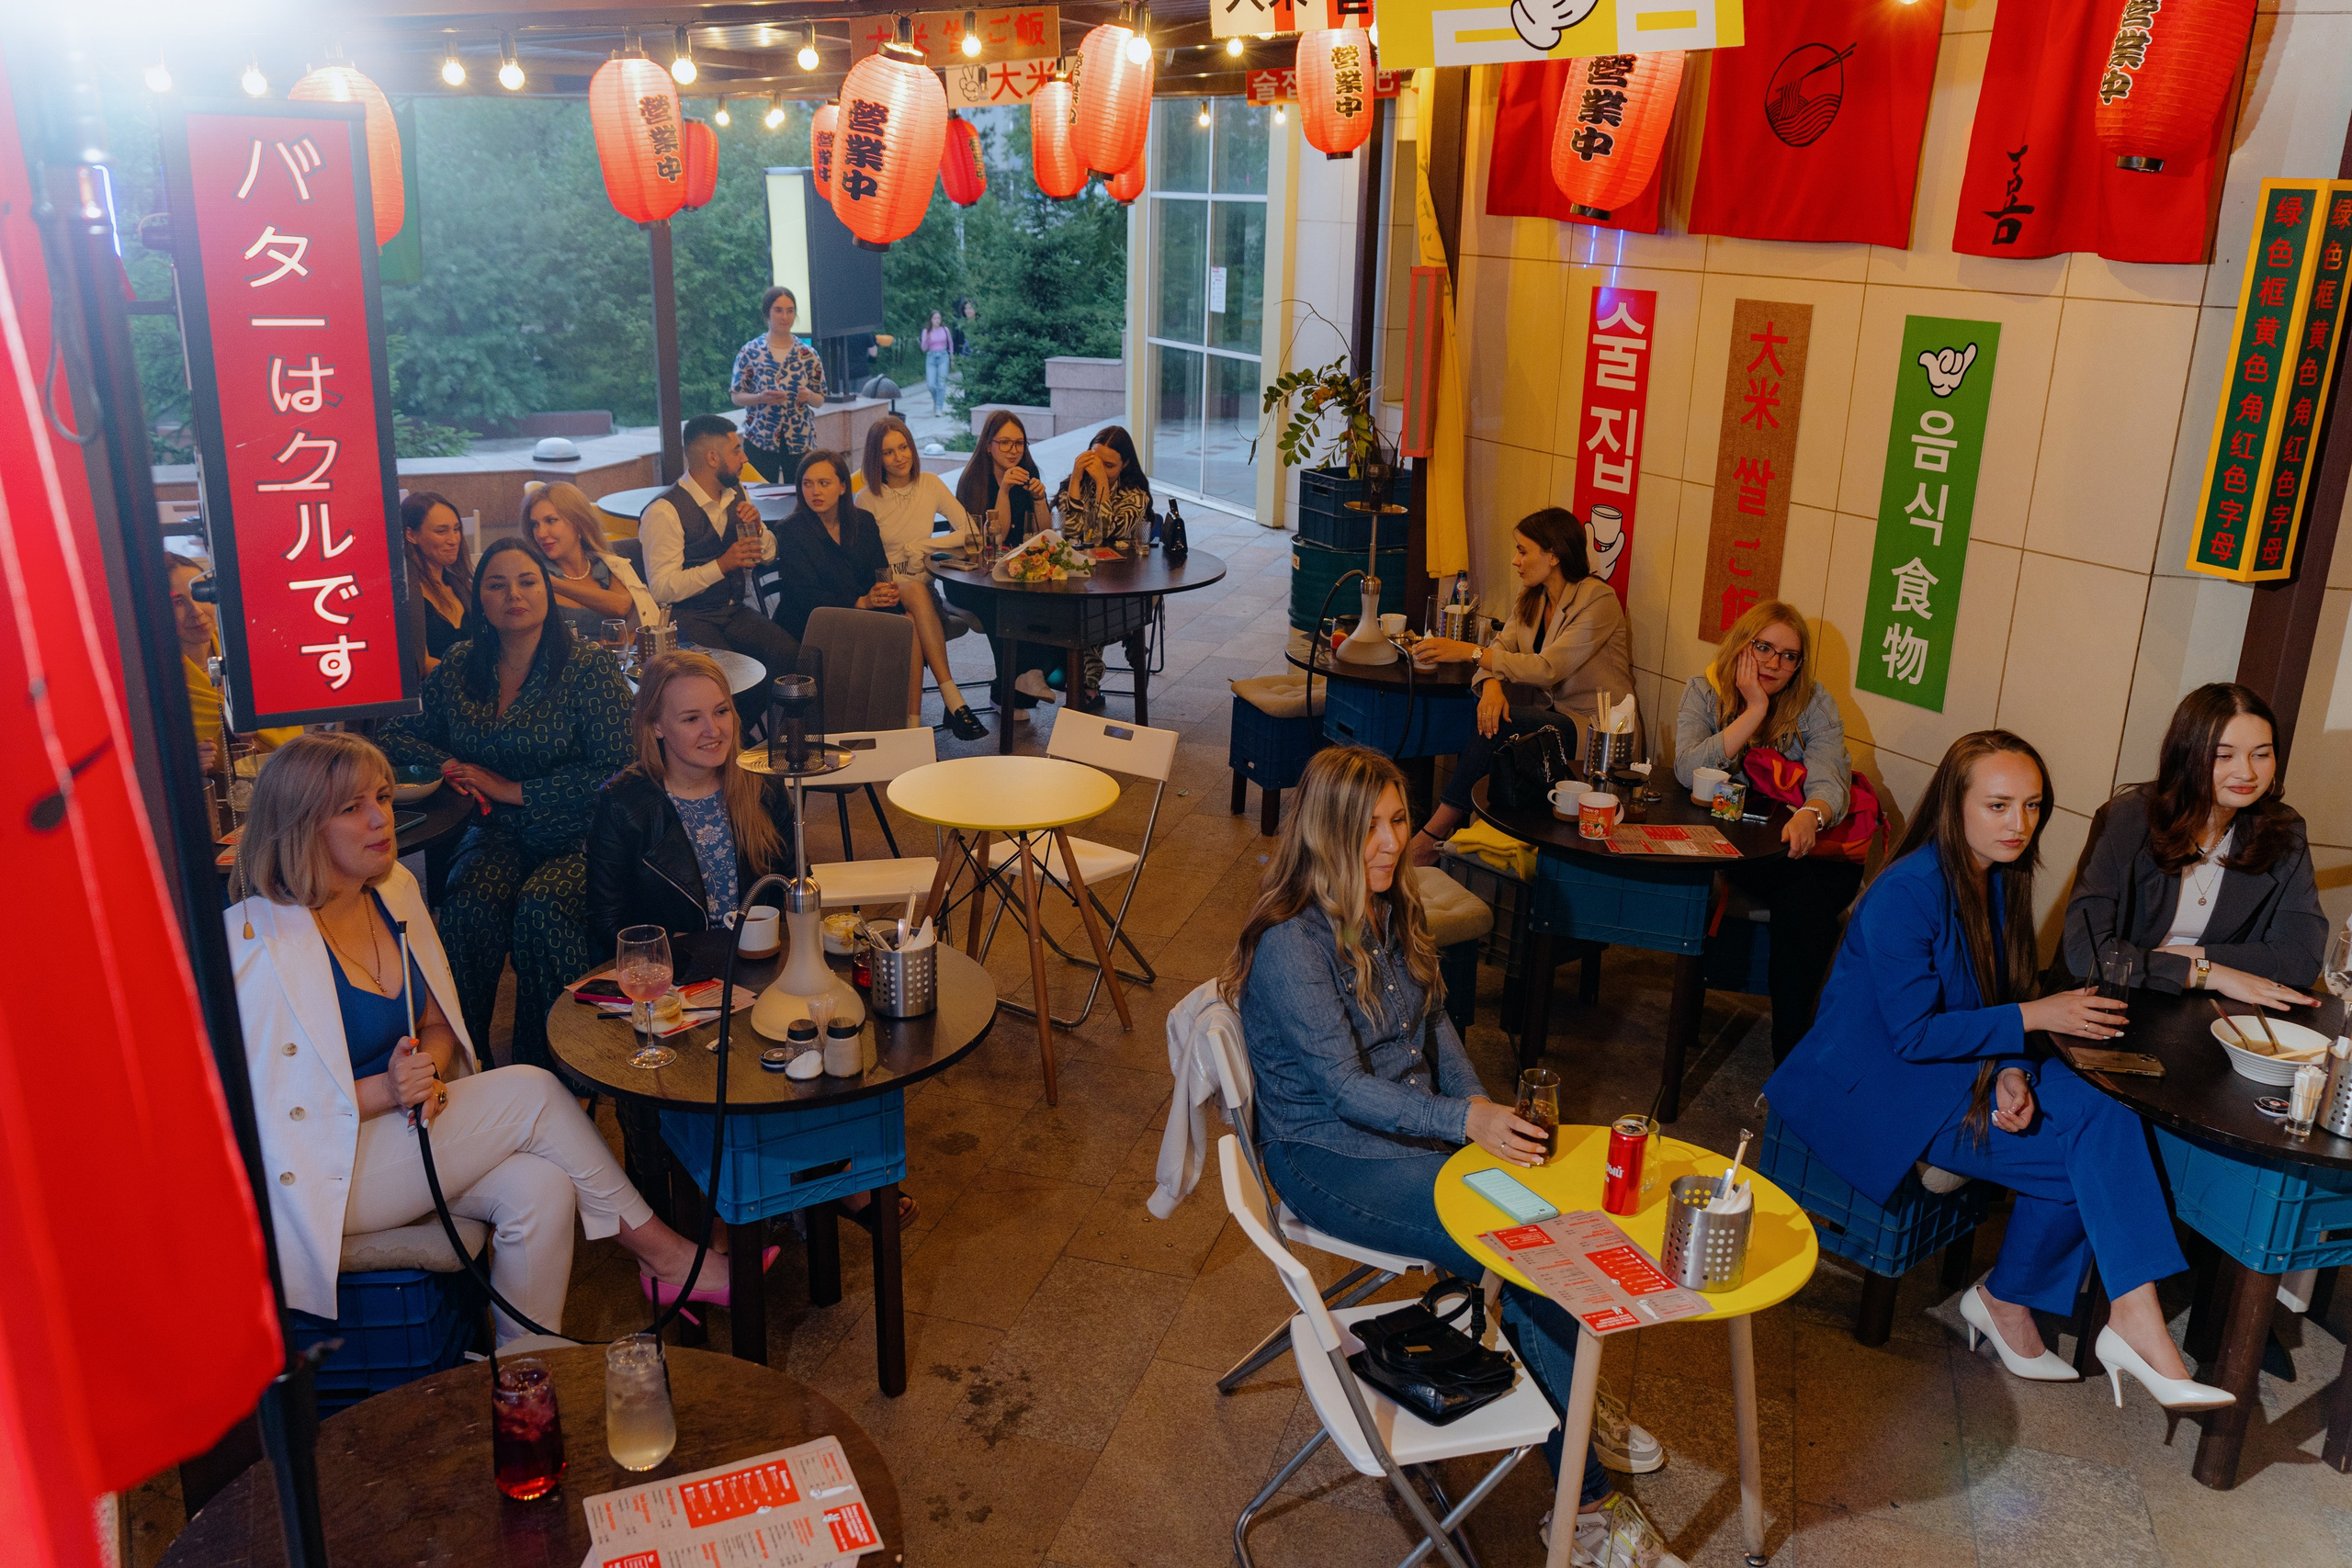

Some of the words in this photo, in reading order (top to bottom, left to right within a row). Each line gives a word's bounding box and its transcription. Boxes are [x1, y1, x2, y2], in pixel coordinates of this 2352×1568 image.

[989, 12, 1046, 47] ご飯
[1586, 301, 1646, 495] 술집
[1740, 321, 1789, 431] 大米
[2211, 196, 2304, 561] 绿色框黄色角红色字母
[1733, 456, 1776, 517] 쌀
